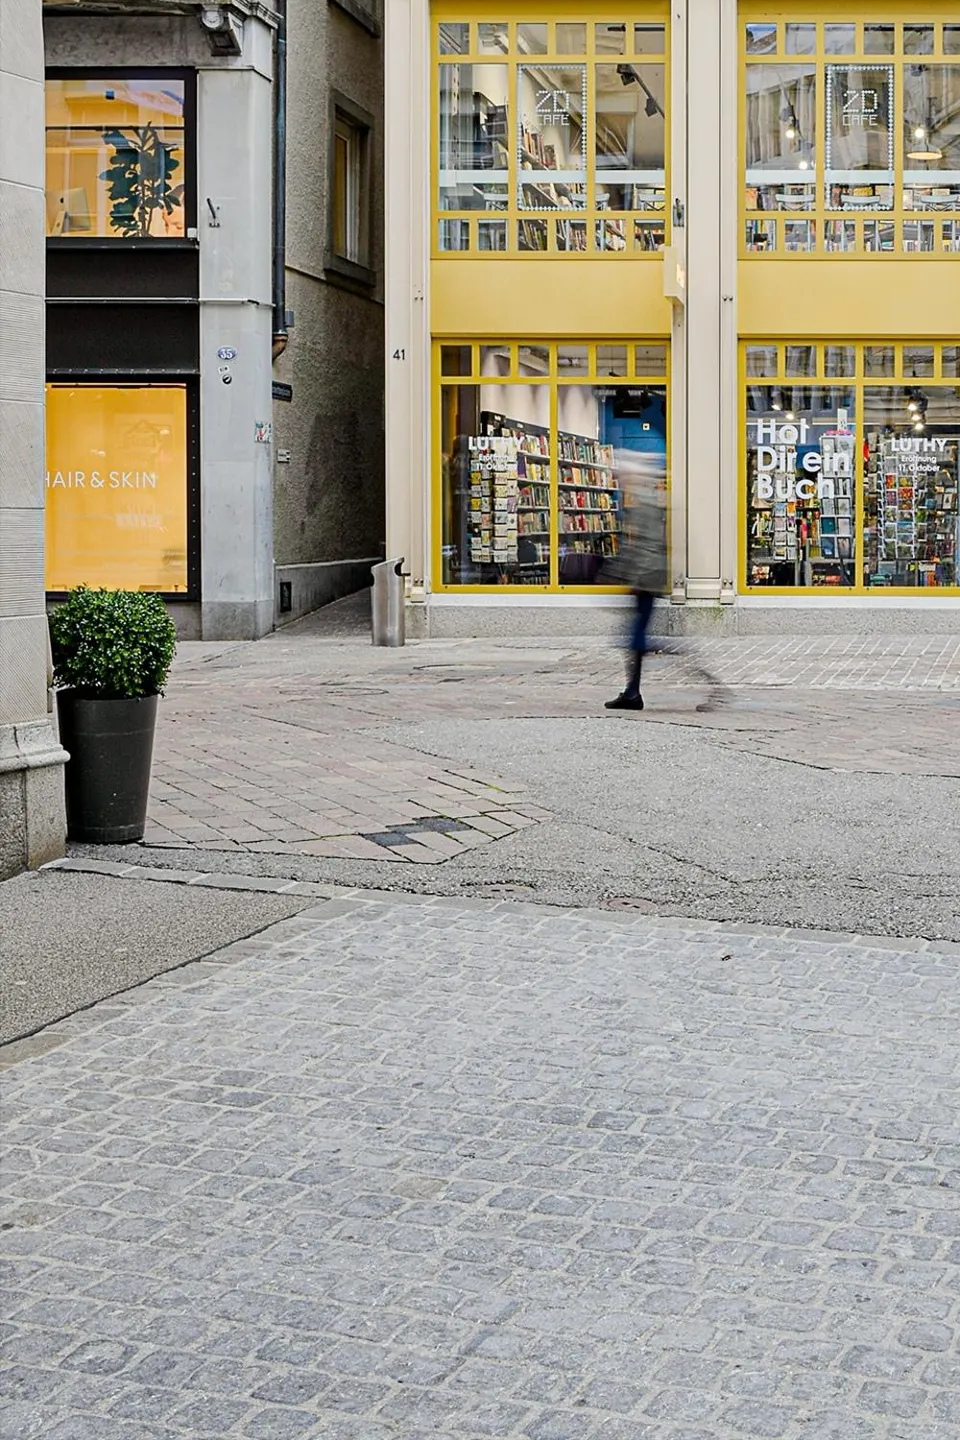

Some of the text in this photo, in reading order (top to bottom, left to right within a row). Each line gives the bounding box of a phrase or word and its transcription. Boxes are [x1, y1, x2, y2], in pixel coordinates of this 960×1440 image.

[536, 90, 570, 113] 2D
[843, 90, 878, 113] 2D
[843, 114, 878, 126] CAFE
[219, 349, 233, 359] 35
[392, 349, 405, 361] 41
[757, 418, 807, 445] Hol
[757, 445, 850, 473] Dir ein
[90, 471, 105, 489] &
[109, 471, 158, 489] SKIN
